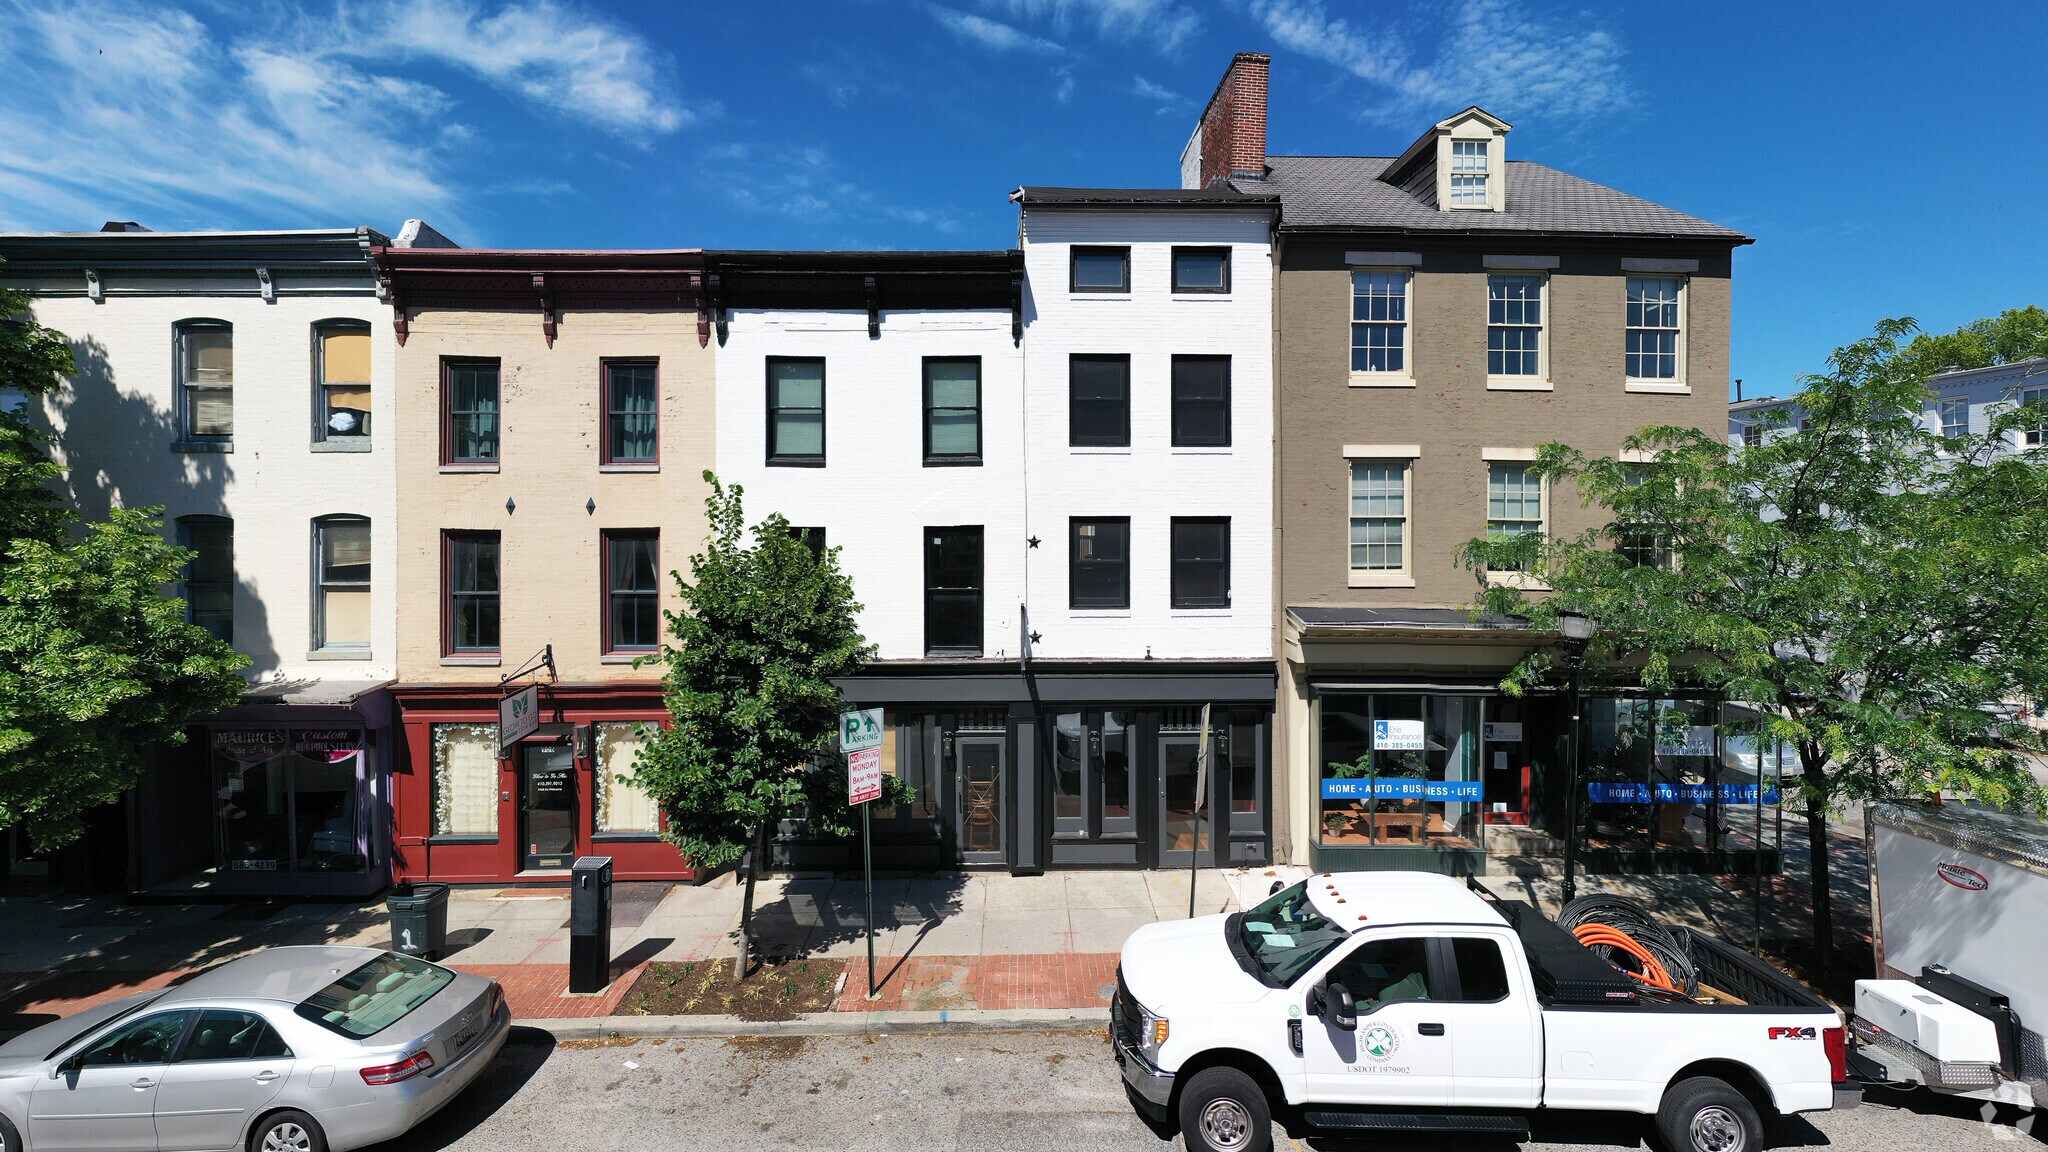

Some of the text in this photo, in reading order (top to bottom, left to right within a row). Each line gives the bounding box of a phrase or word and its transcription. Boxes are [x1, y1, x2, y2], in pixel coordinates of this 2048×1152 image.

[503, 712, 536, 735] GLOW TO GO
[217, 730, 284, 744] MAURICE'S
[302, 730, 348, 741] Custom
[225, 745, 246, 754] House
[249, 746, 256, 754] of
[296, 742, 354, 752] REUPHOLSTERY
[850, 750, 880, 763] NO PARKING
[852, 760, 878, 772] MONDAY
[1329, 784, 1478, 796] HOME AUTO BUSINESS LIFE
[1609, 789, 1758, 798] HOME AUTO BUSINESS LIFE
[1936, 861, 1966, 876] Mobile
[1968, 878, 1988, 890] Tech
[401, 928, 417, 950] 1
[1768, 1027, 1816, 1040] FX4
[1366, 1054, 1392, 1063] COMPANY
[1347, 1065, 1410, 1074] USDOT 1979902
